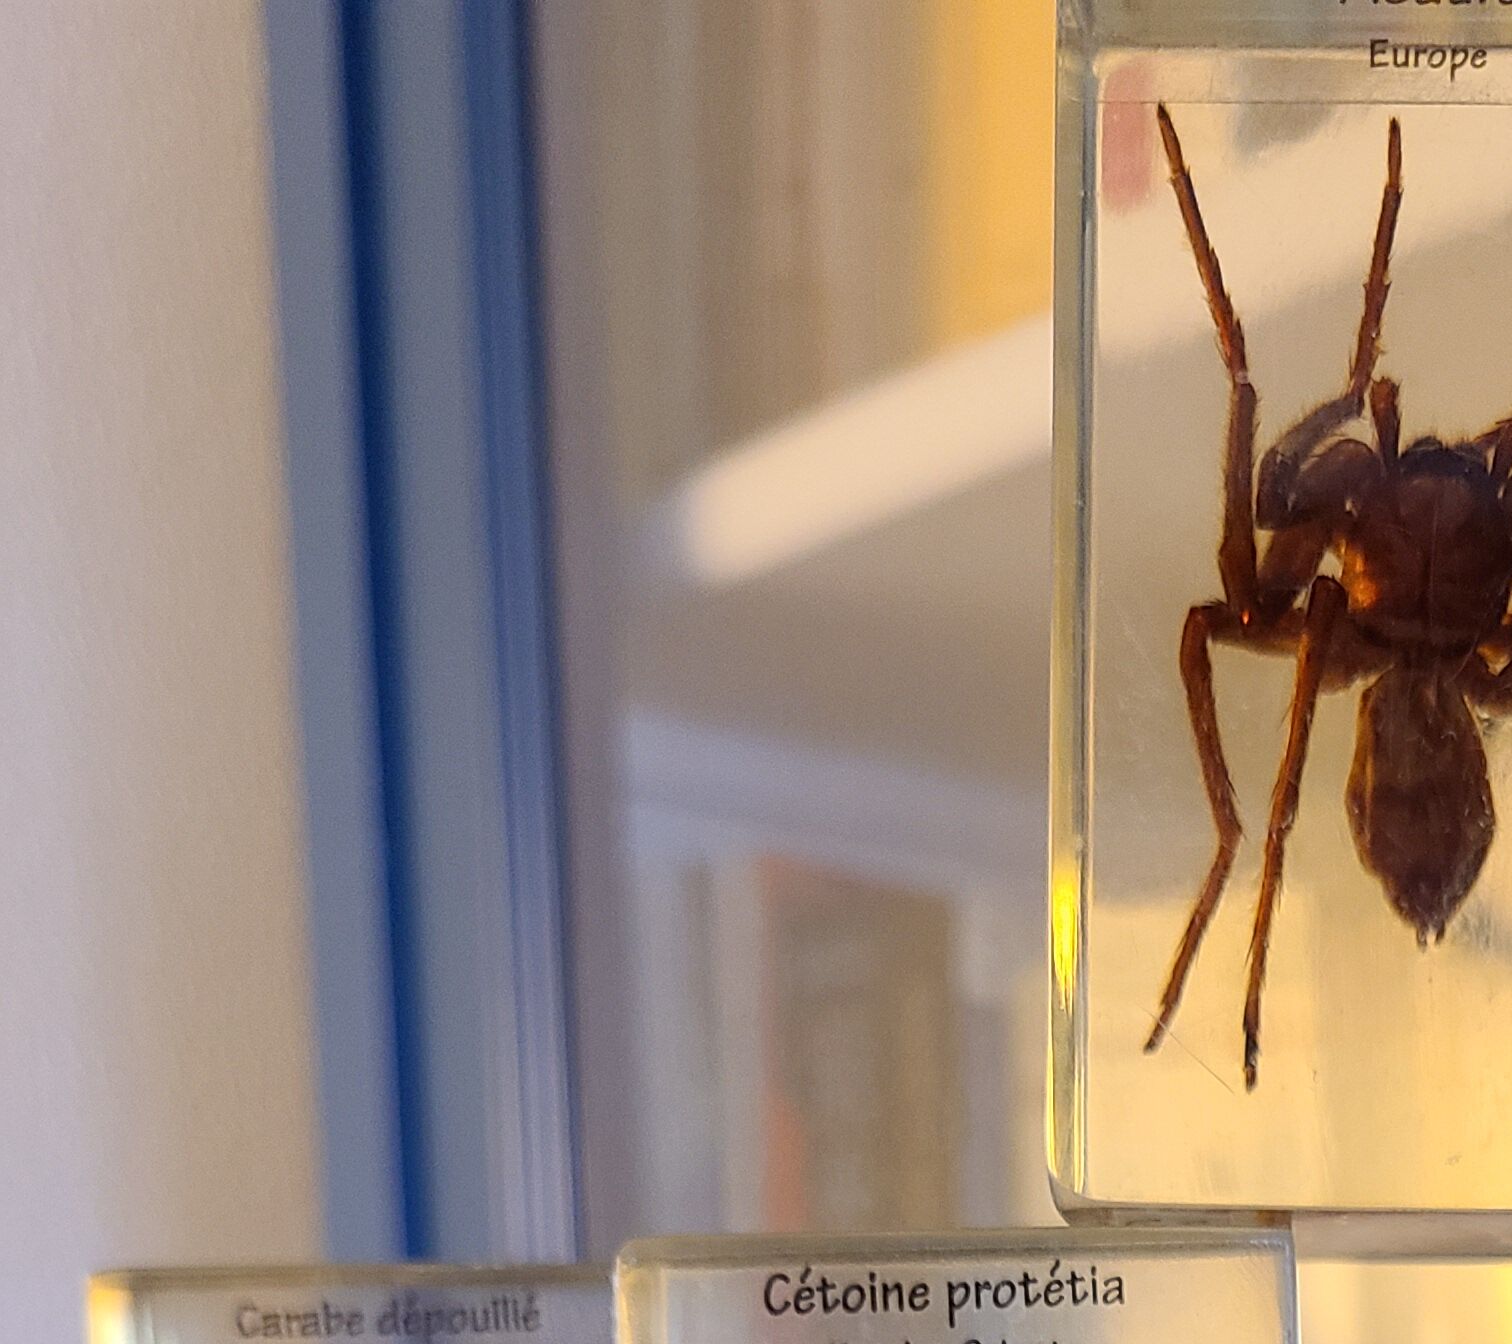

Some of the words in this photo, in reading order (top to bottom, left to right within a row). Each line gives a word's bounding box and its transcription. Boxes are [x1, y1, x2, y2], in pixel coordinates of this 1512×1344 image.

[1369, 39, 1487, 82] Europe
[764, 1266, 930, 1316] Cétoine
[947, 1259, 1127, 1328] protétia
[236, 1303, 366, 1338] Carabe
